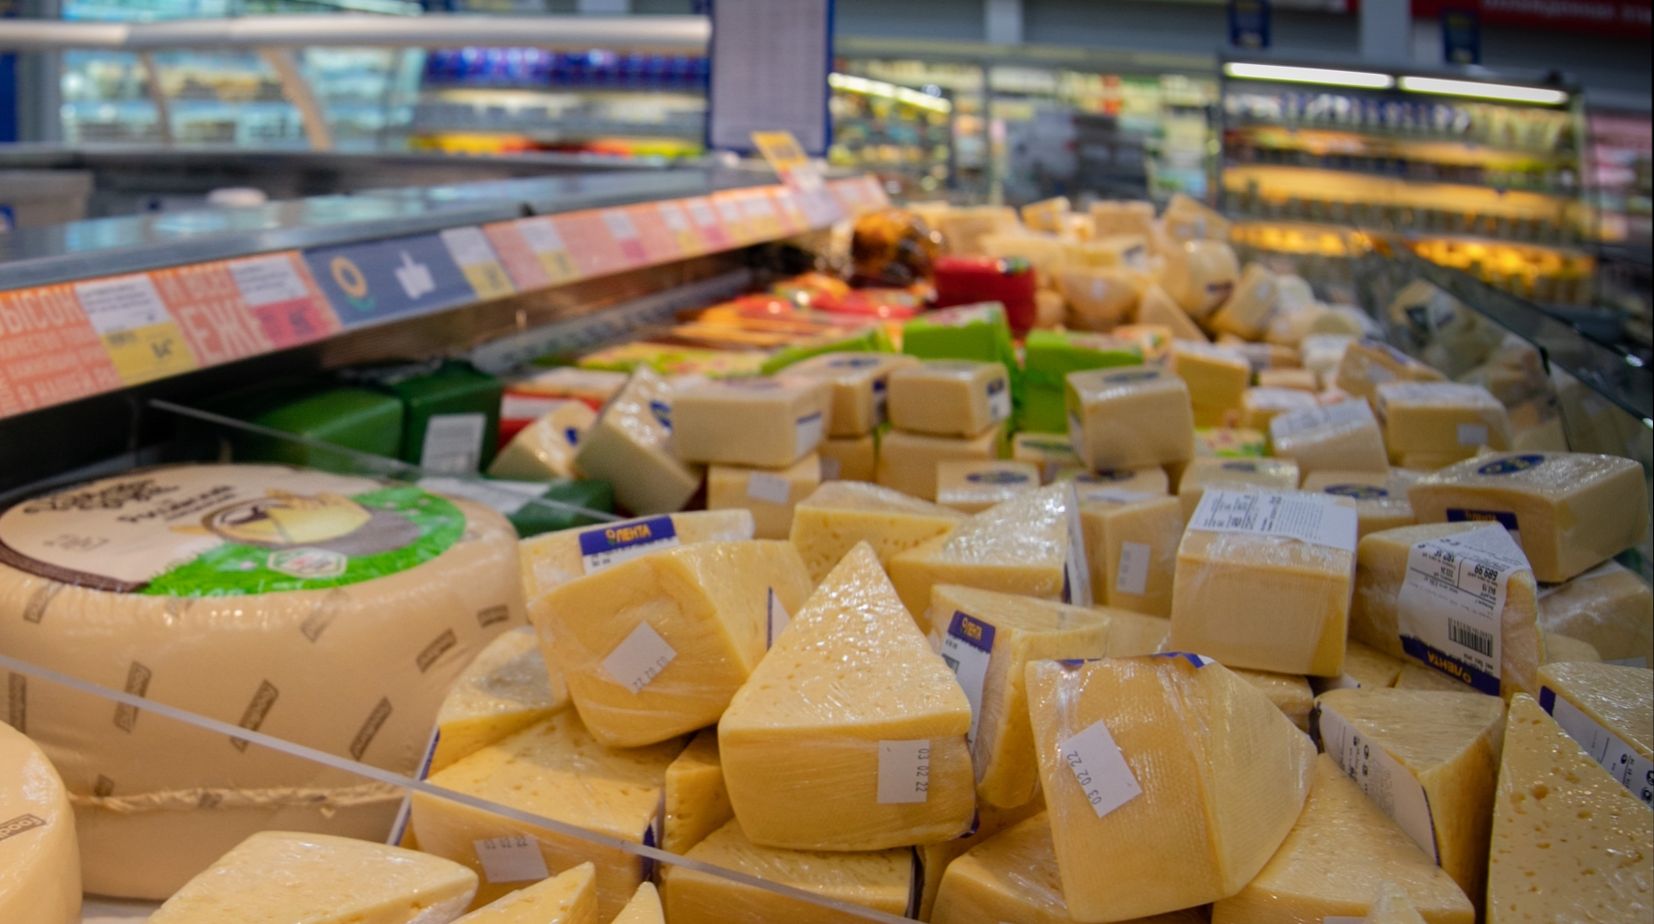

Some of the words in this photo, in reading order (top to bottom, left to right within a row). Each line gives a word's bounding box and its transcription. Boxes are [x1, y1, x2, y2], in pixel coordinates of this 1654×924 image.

[615, 523, 652, 543] ЛЕНТА
[1427, 651, 1463, 680] ЛЕНТА
[918, 748, 929, 760] 03
[1066, 750, 1082, 768] 22
[916, 765, 928, 777] 02
[1076, 769, 1092, 786] 02
[915, 781, 928, 792] 22
[1087, 789, 1102, 805] 03
